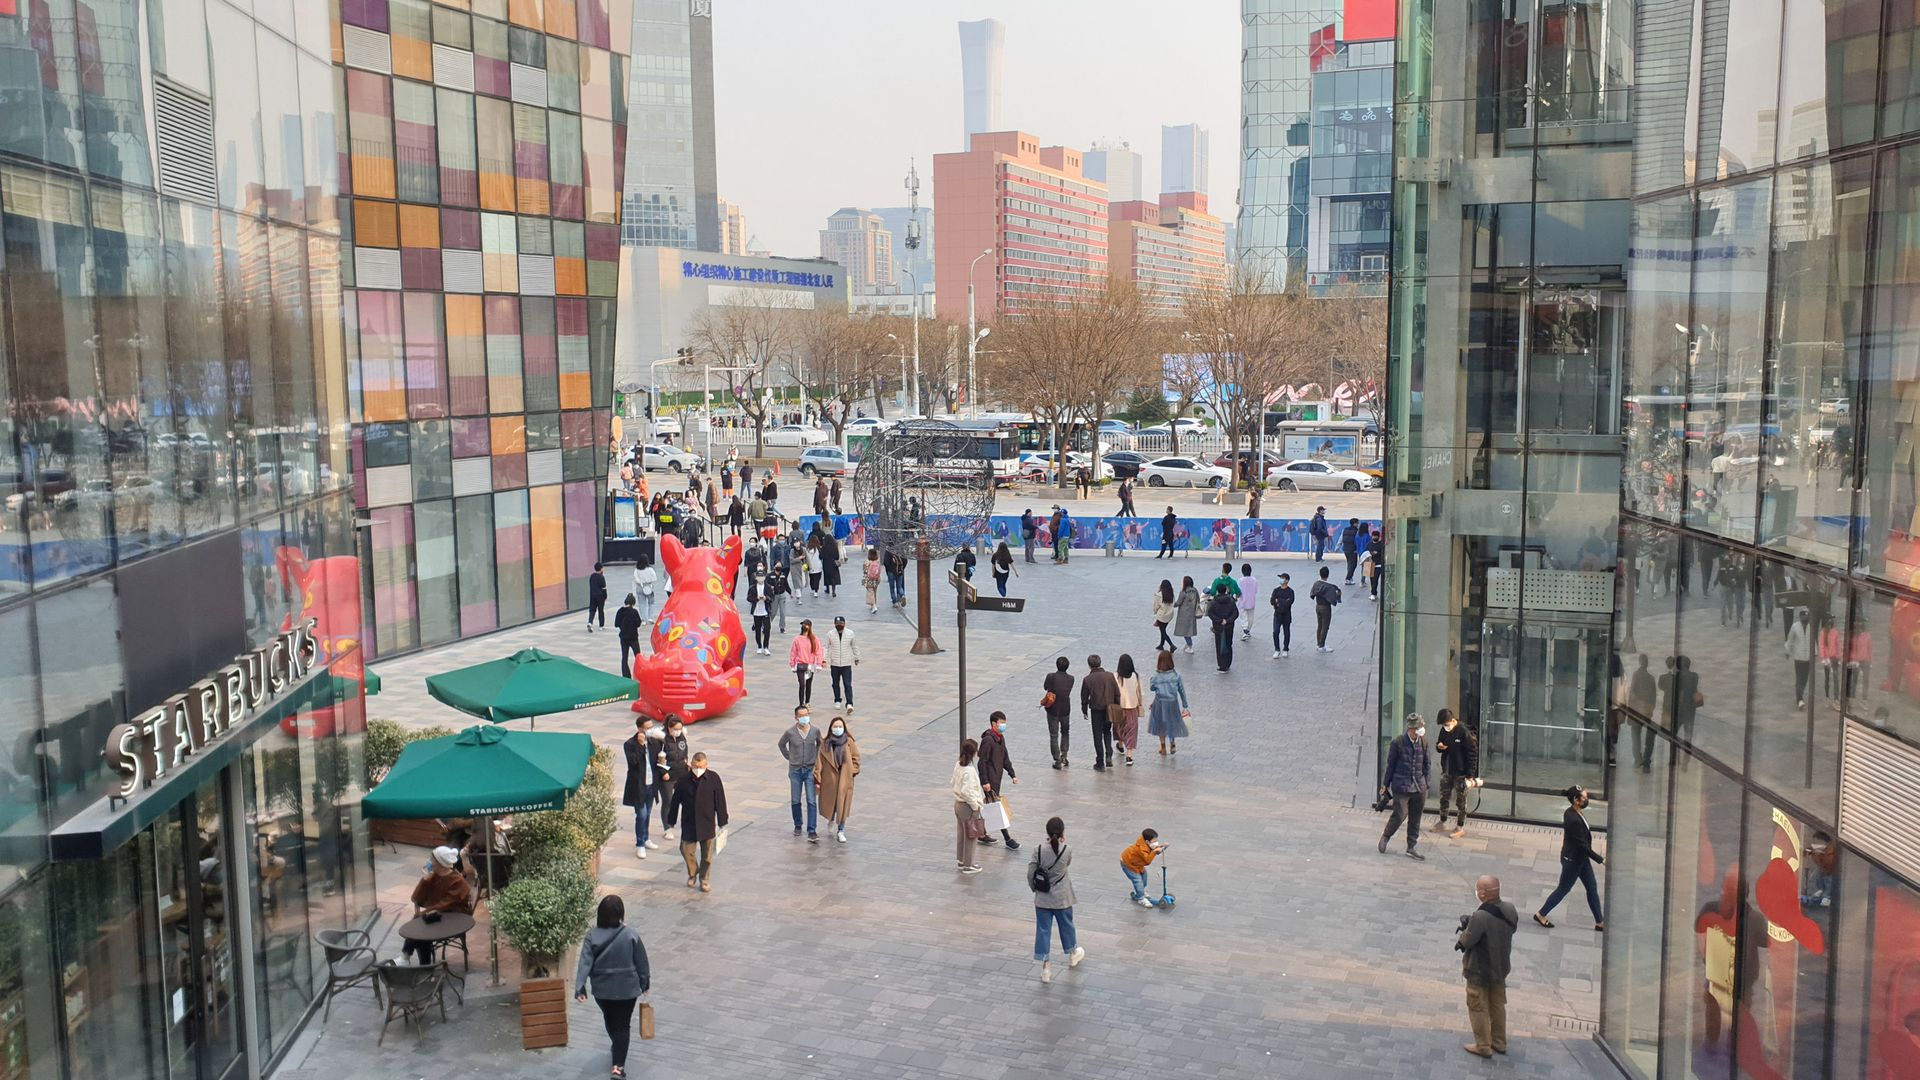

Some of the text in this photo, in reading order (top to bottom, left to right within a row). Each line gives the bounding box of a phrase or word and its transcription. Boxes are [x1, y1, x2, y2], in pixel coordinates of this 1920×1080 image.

[108, 617, 317, 797] STARBUCKS
[469, 801, 553, 815] STARBUCKS COFFEE
